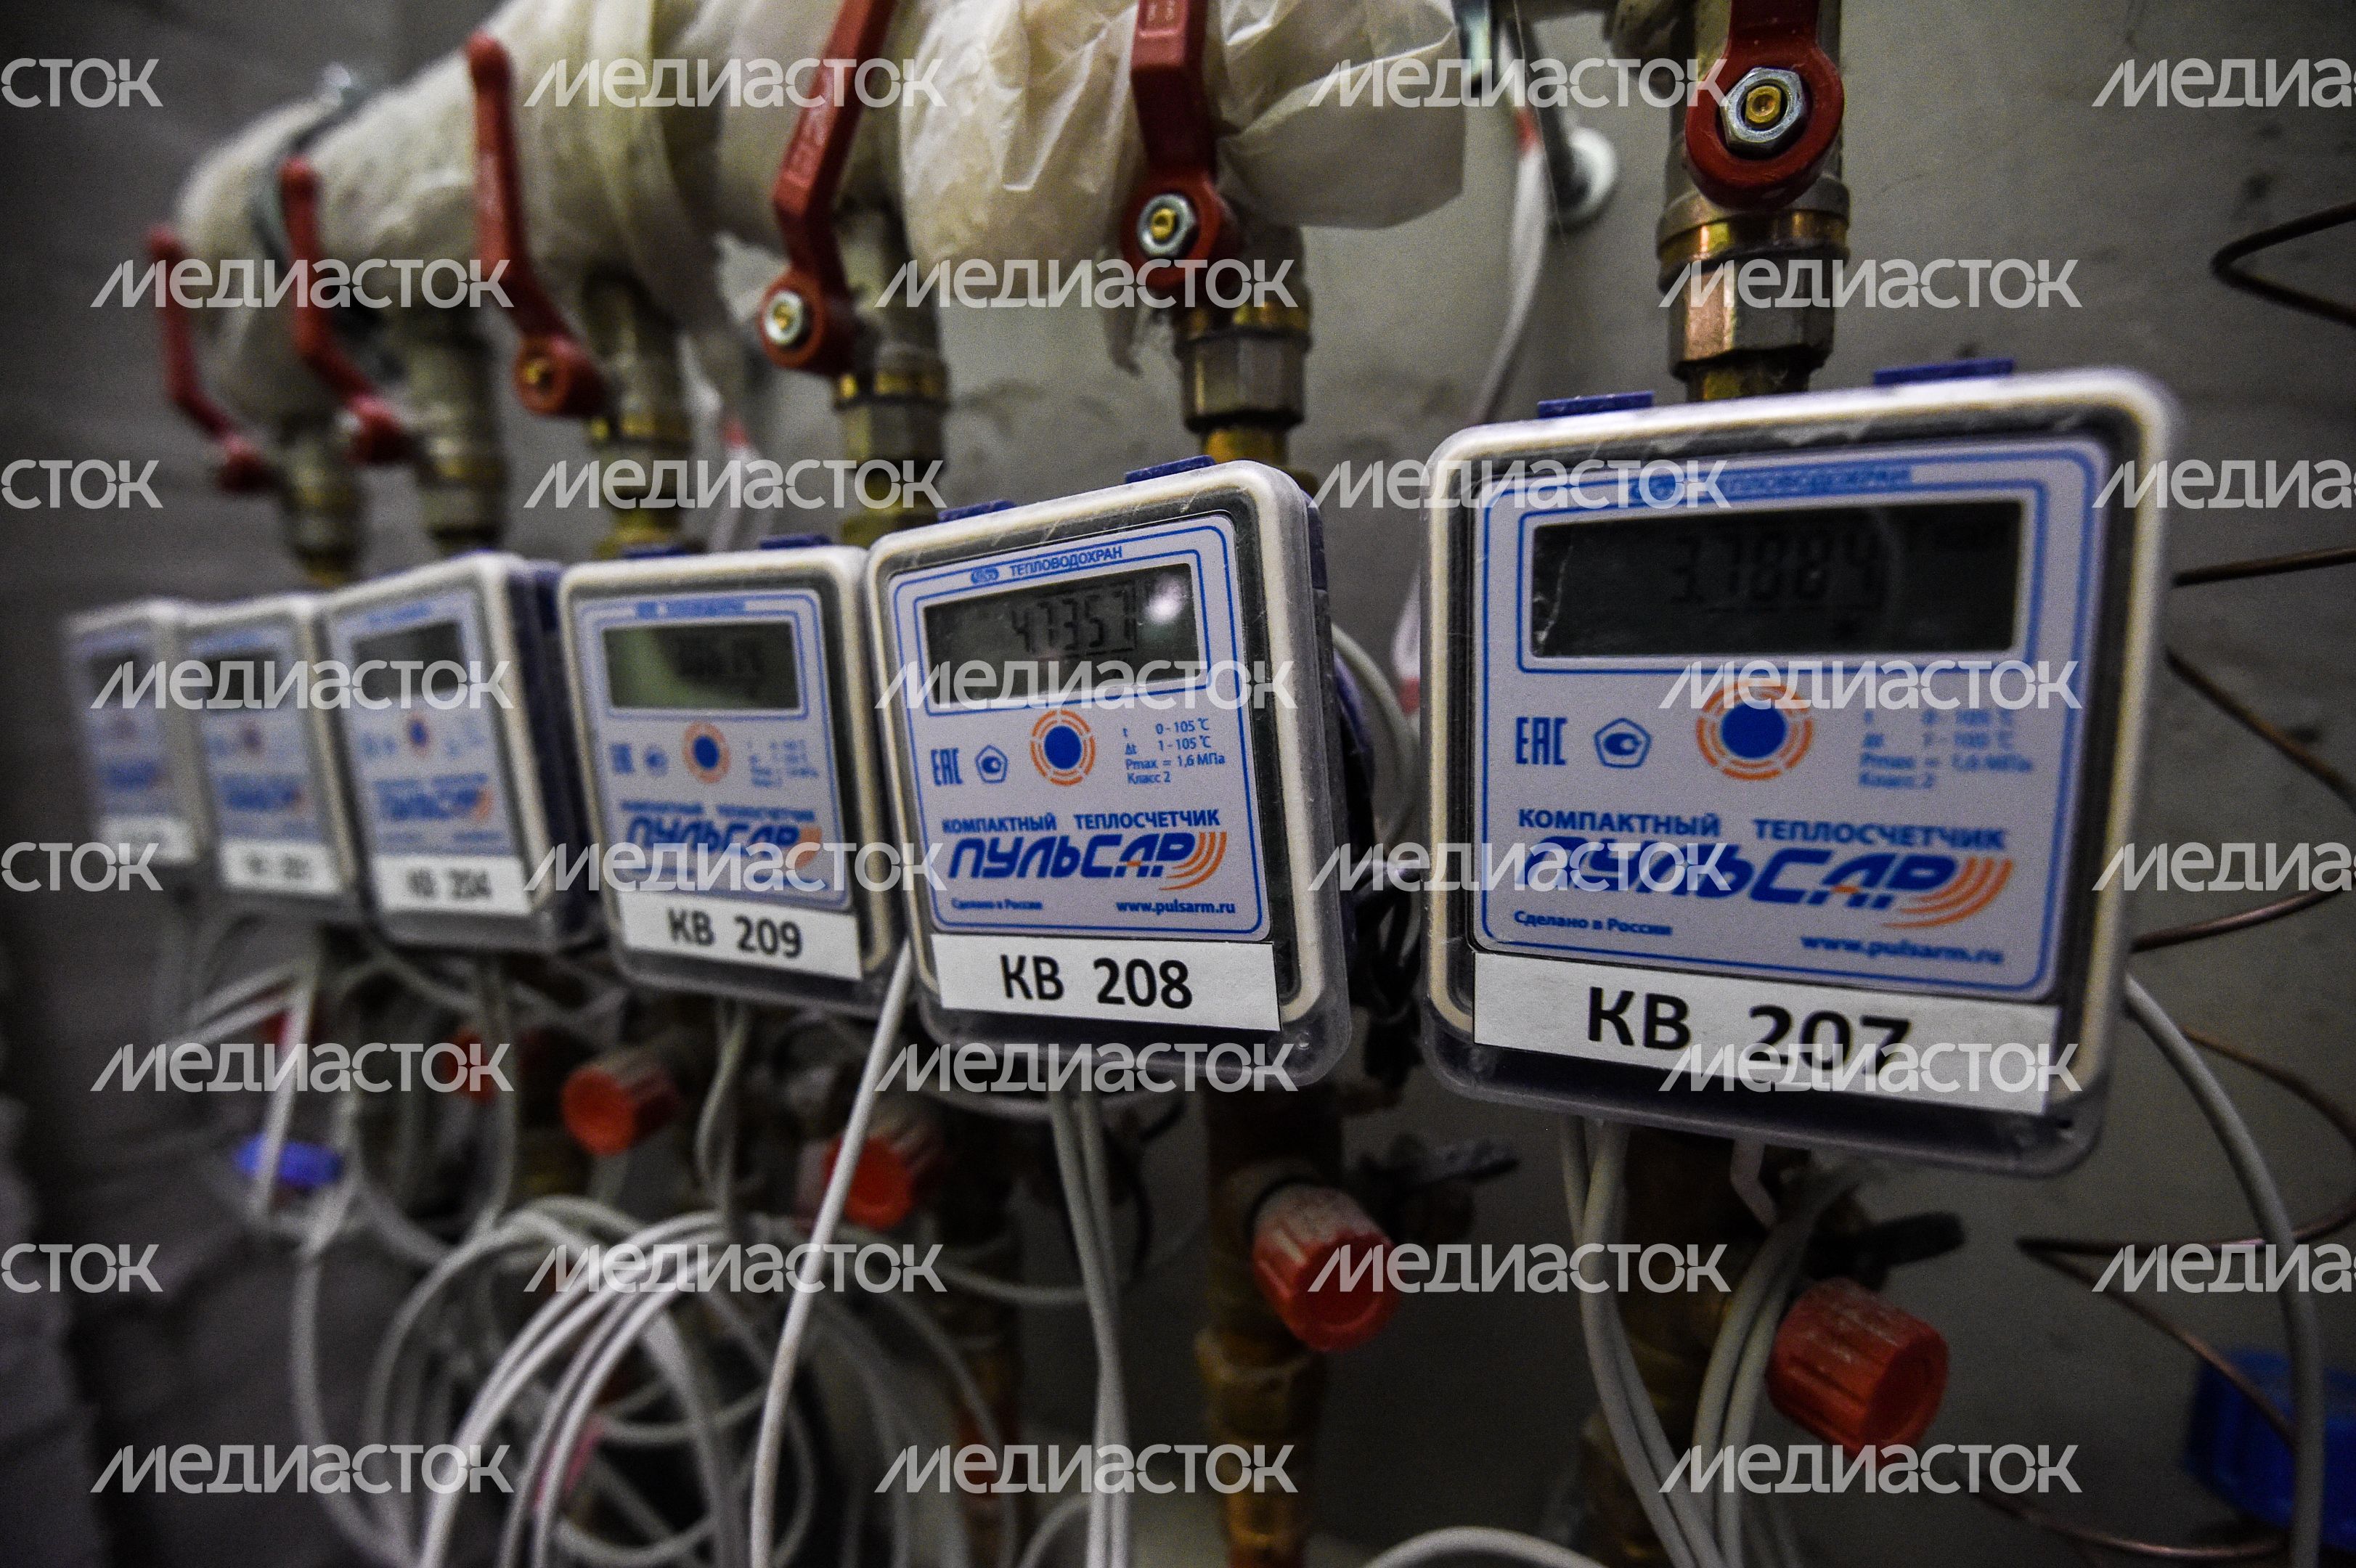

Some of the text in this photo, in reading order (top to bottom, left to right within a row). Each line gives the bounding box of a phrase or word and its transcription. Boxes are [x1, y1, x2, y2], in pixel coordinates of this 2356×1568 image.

[1009, 545, 1123, 577] ТЕПЛОВОДОХРАН
[942, 809, 1221, 834] КОМПАКТНЫЙ ТЕПЛОСЧЕТЧИК
[1518, 807, 2006, 851] КОМПАКТНЫЙ ТЕПЛОСЧЕТЧИК
[948, 831, 1197, 879] ПУЛЬСАР
[1116, 899, 1236, 915] www.pulsarm.ru
[1514, 910, 1589, 927] Сделано
[1591, 919, 1603, 930] в
[667, 907, 803, 959] КВ 209
[1000, 954, 1193, 1010] КВ 208
[1588, 986, 1912, 1076] КВ 207
